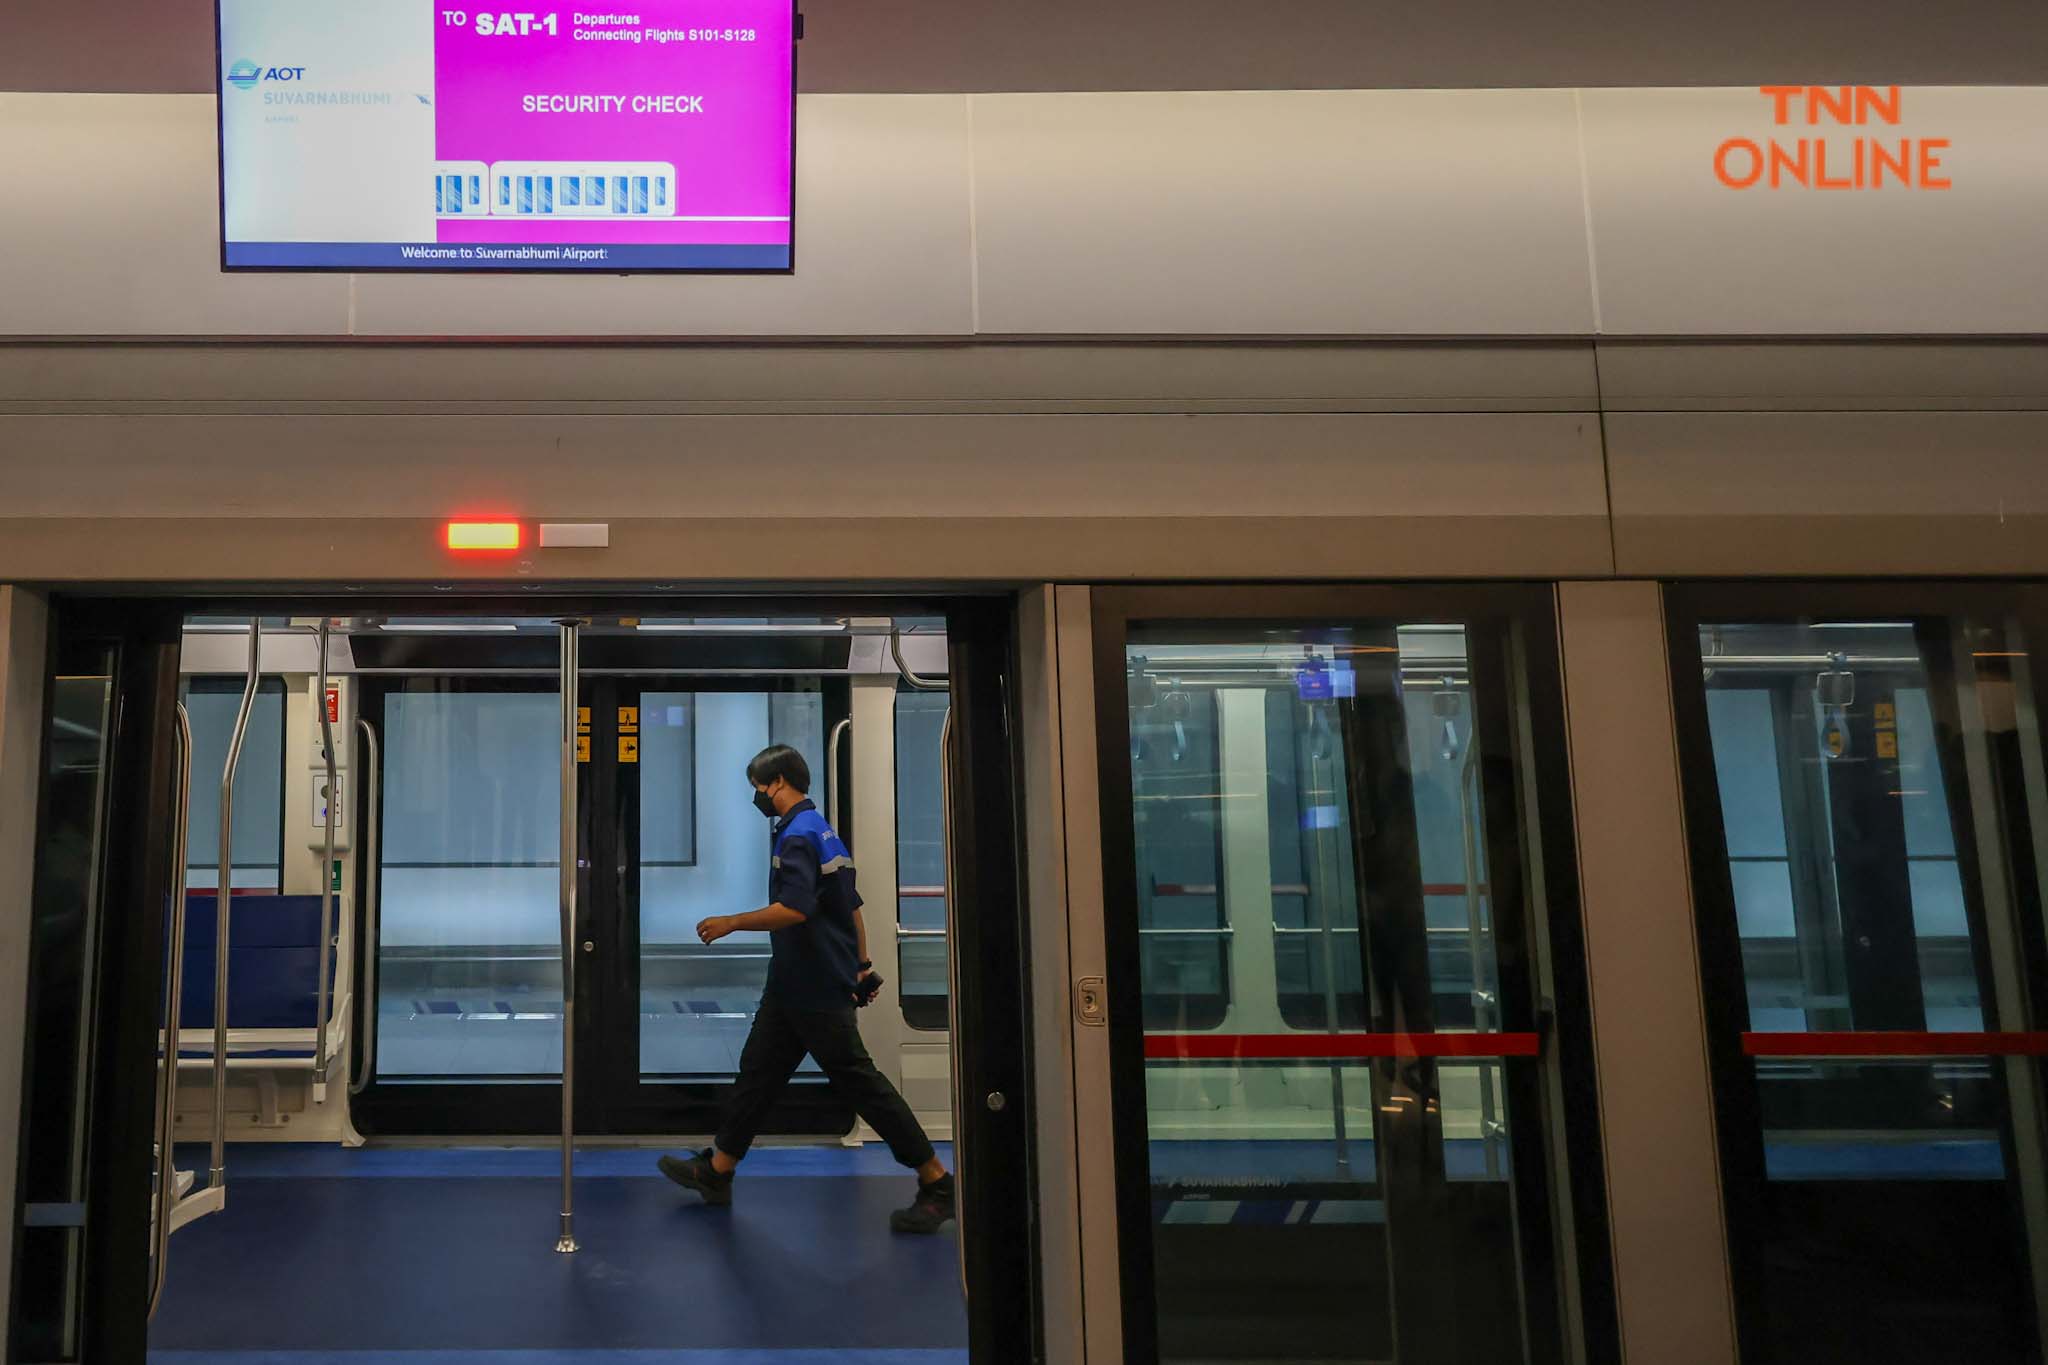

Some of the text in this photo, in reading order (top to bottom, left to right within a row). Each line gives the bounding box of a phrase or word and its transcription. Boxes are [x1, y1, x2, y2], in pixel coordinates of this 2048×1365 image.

[442, 10, 558, 36] TO SAT-1
[573, 12, 640, 25] Departures
[573, 29, 756, 43] Connecting Flights S101-S128
[264, 67, 305, 81] AOT
[264, 90, 391, 105] SUVARNABHUMI
[522, 95, 704, 112] SECURITY CHECK
[401, 246, 605, 262] Welcome to Suvarnabhumi Airport
